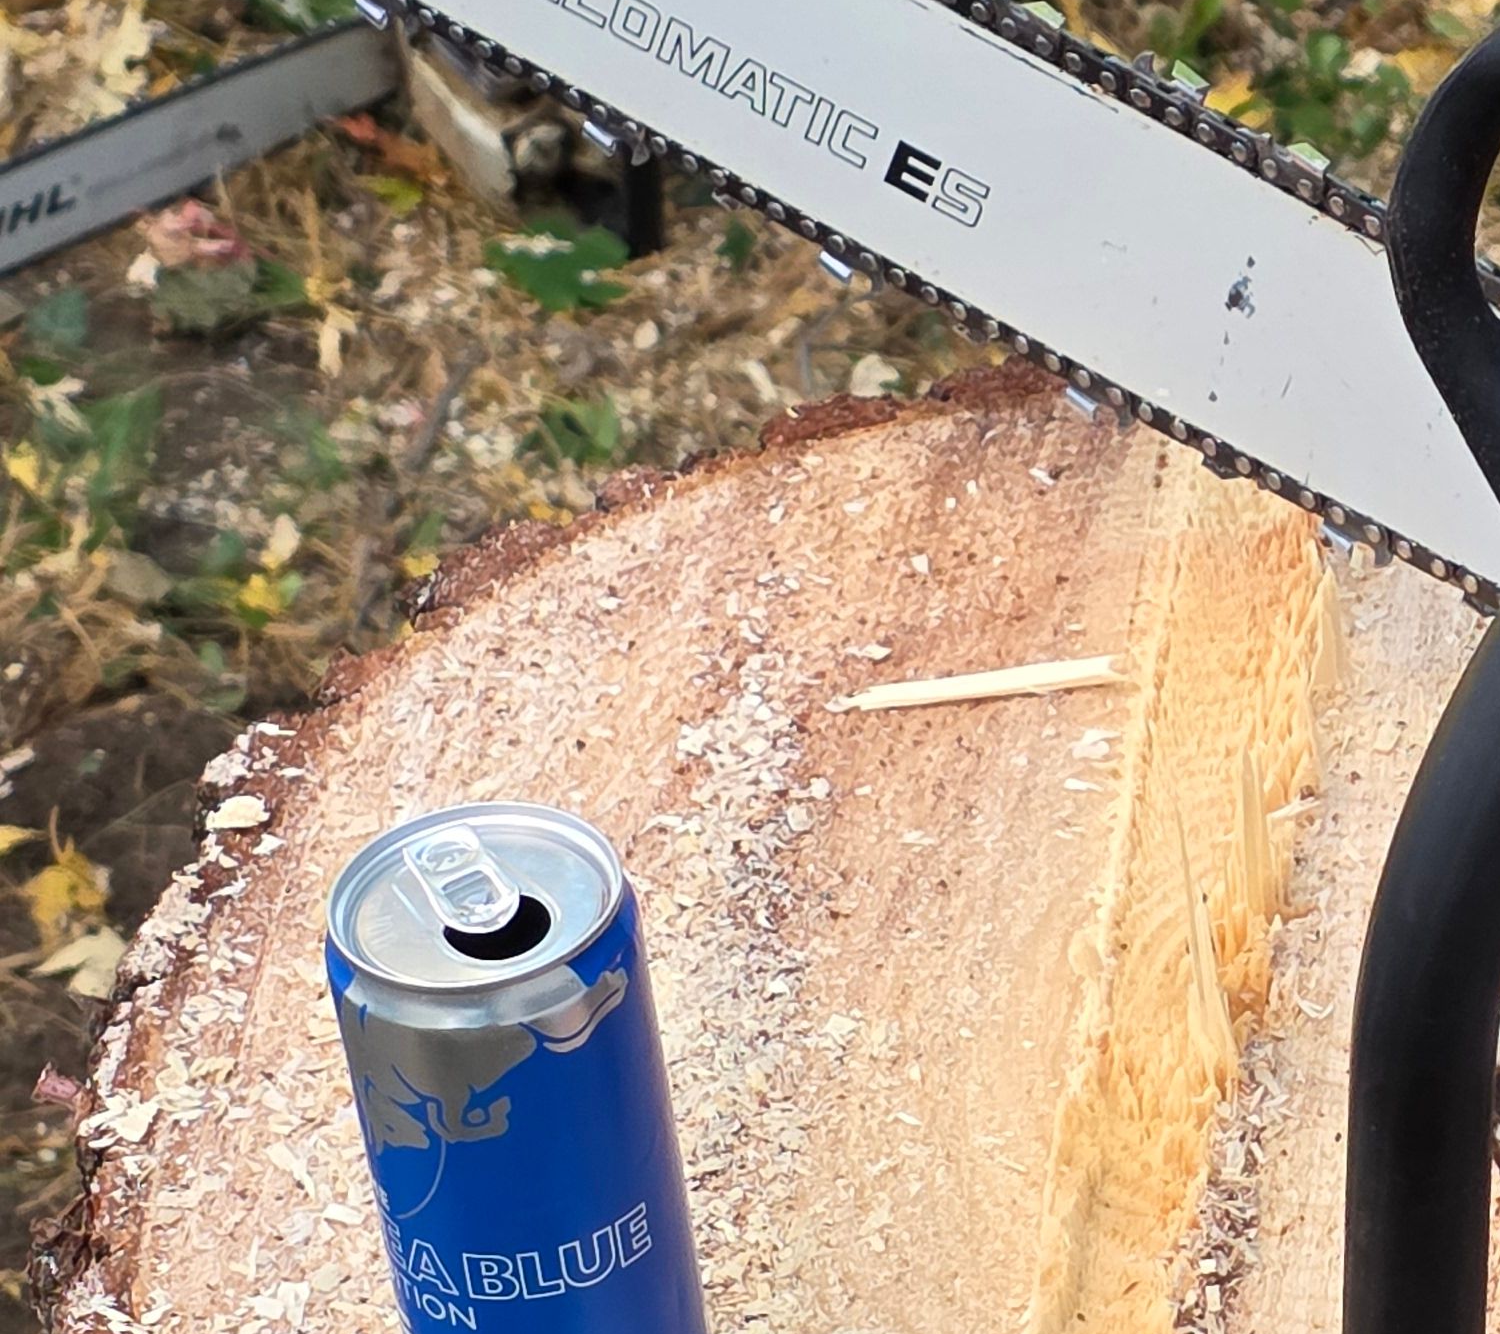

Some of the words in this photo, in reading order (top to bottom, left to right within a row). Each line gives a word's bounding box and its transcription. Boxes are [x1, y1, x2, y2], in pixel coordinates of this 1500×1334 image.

[884, 139, 990, 227] ES
[380, 1215, 459, 1296] EA
[462, 1201, 652, 1301] BLUE
[396, 1270, 477, 1331] TION
